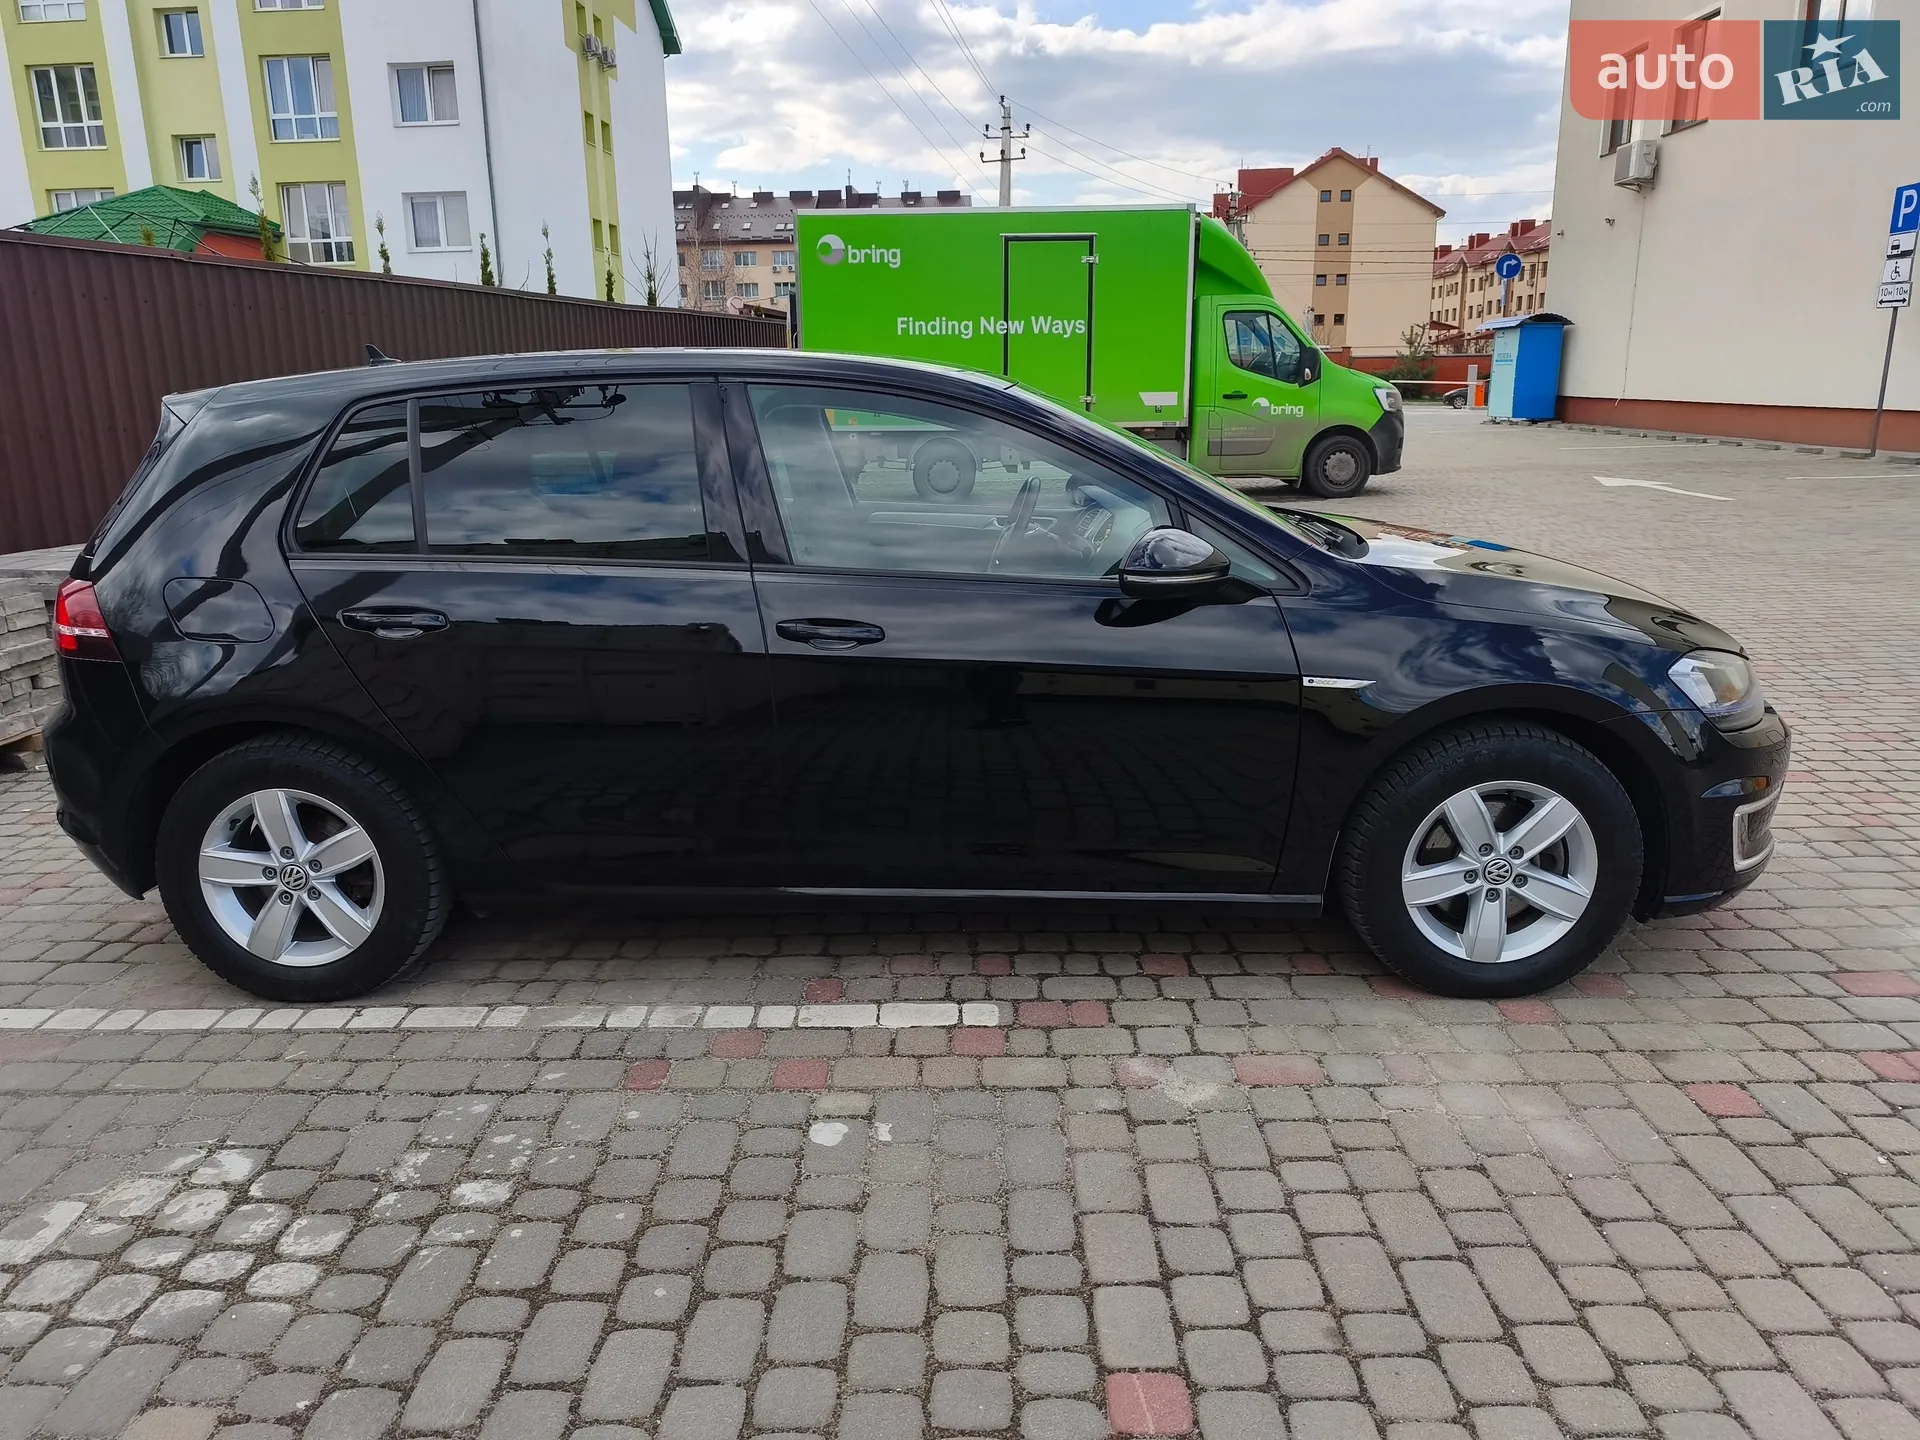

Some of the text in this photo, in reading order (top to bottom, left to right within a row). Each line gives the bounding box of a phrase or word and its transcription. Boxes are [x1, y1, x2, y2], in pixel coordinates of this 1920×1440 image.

[1897, 189, 1918, 228] P
[847, 244, 901, 269] bring
[897, 315, 1086, 339] Finding New Ways
[1270, 403, 1304, 418] bring
